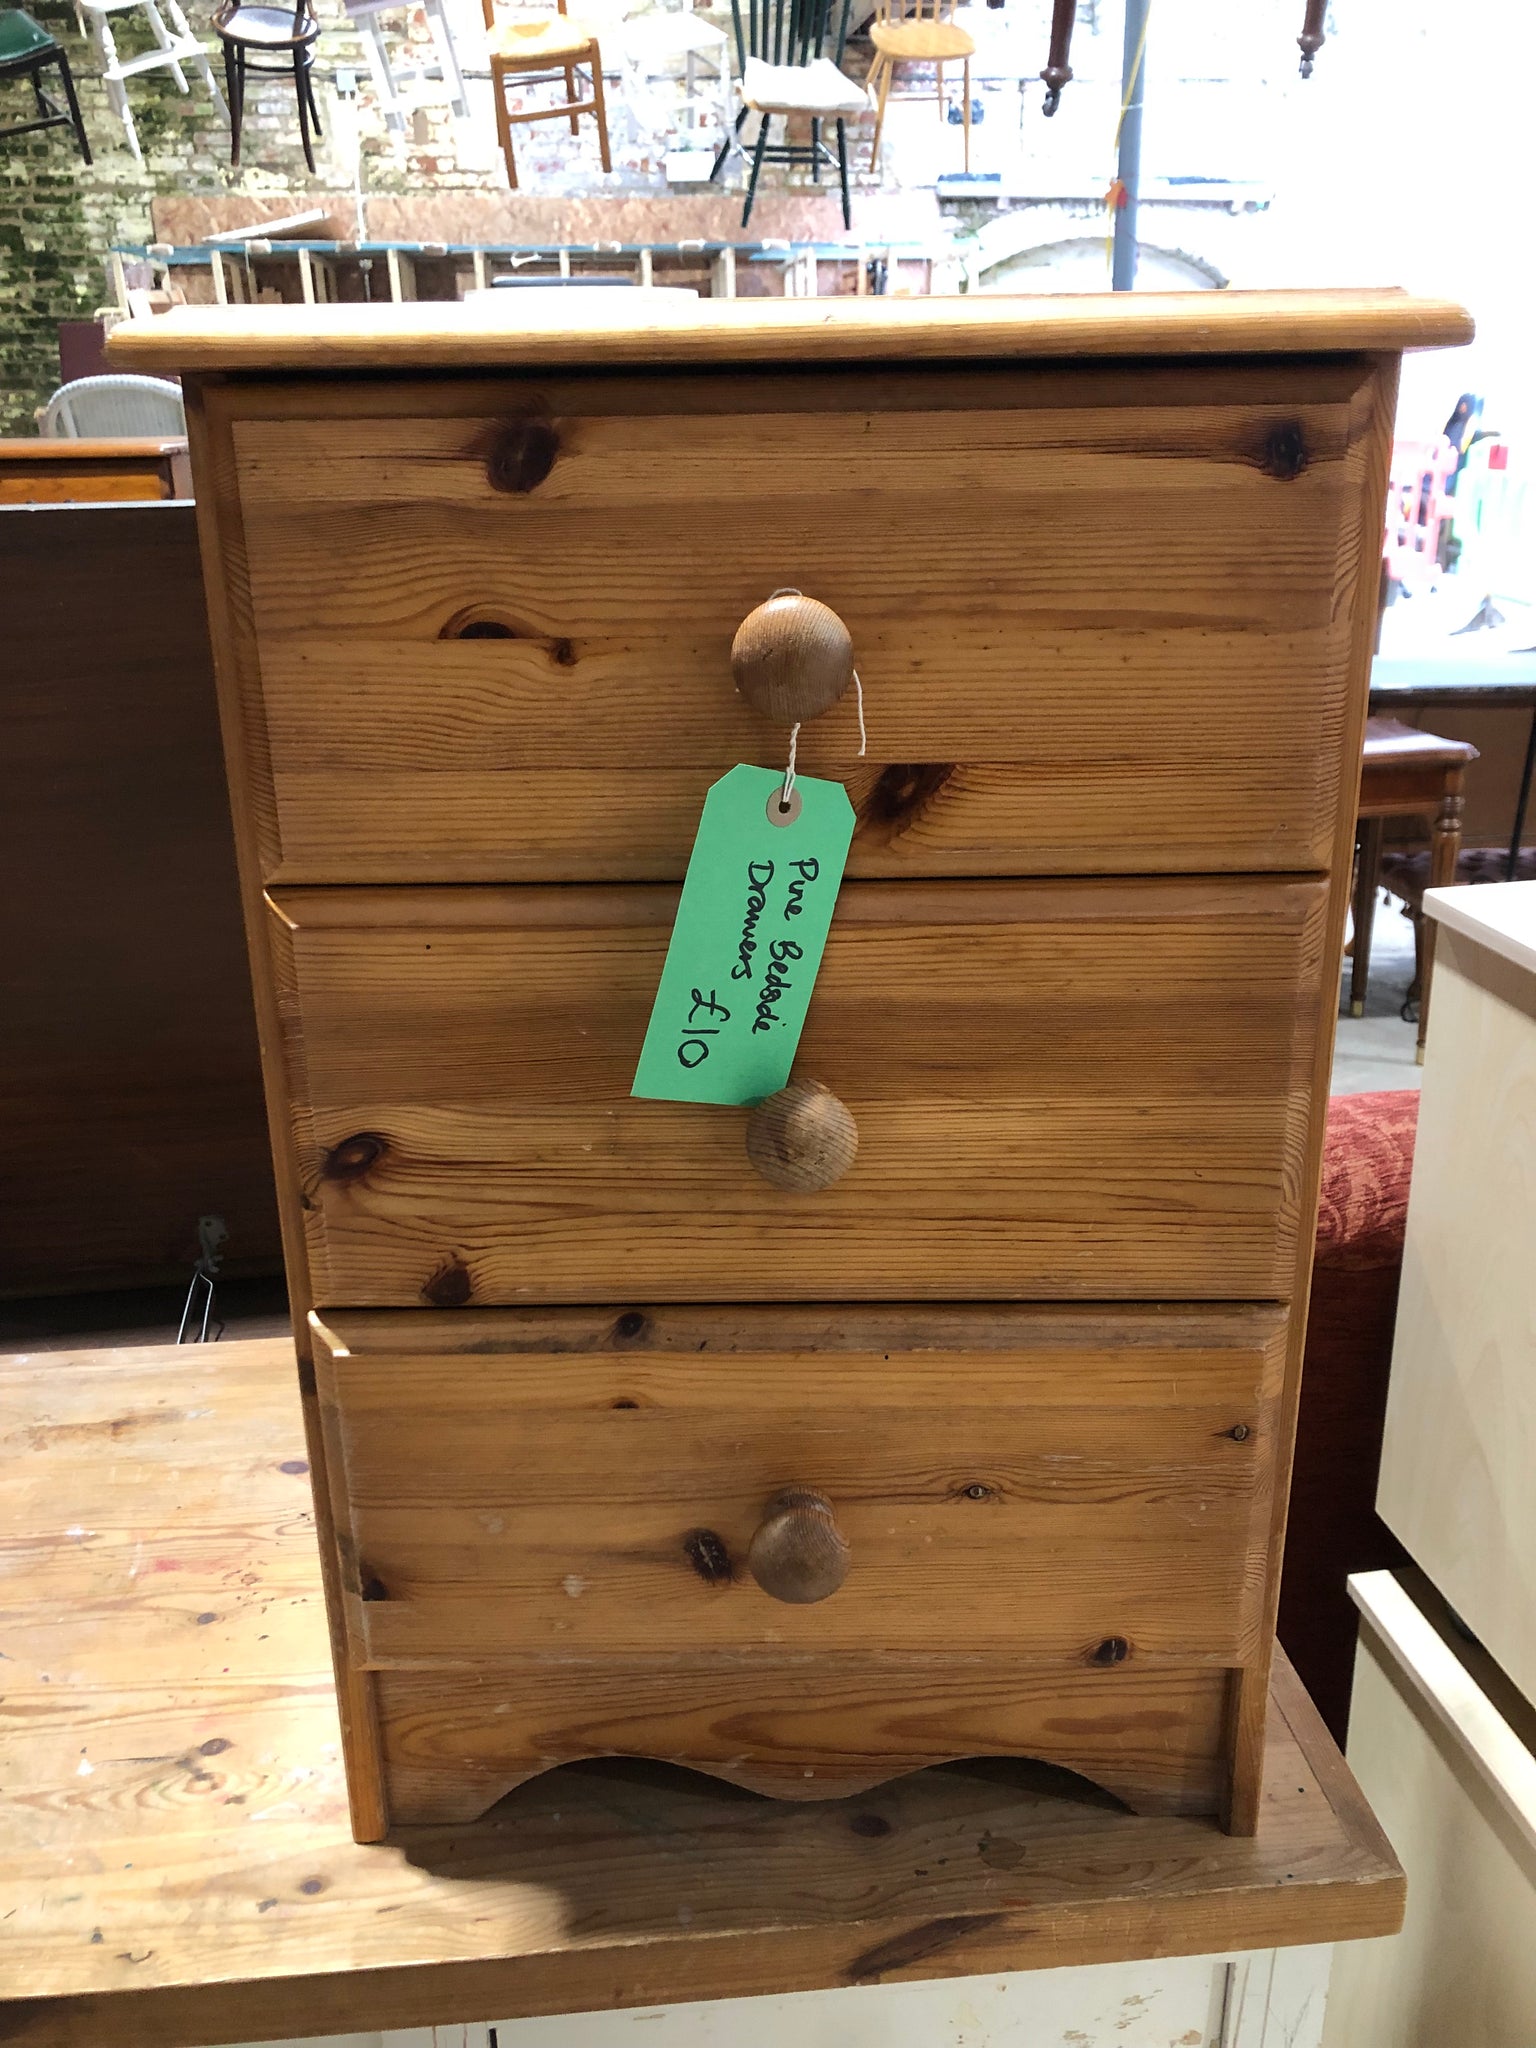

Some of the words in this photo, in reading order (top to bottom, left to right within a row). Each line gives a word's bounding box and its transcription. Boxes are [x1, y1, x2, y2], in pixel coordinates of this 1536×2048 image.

[731, 859, 775, 980] Drawers
[784, 857, 820, 921] Pine
[677, 988, 731, 1068] £10
[751, 940, 804, 1035] Bedside
